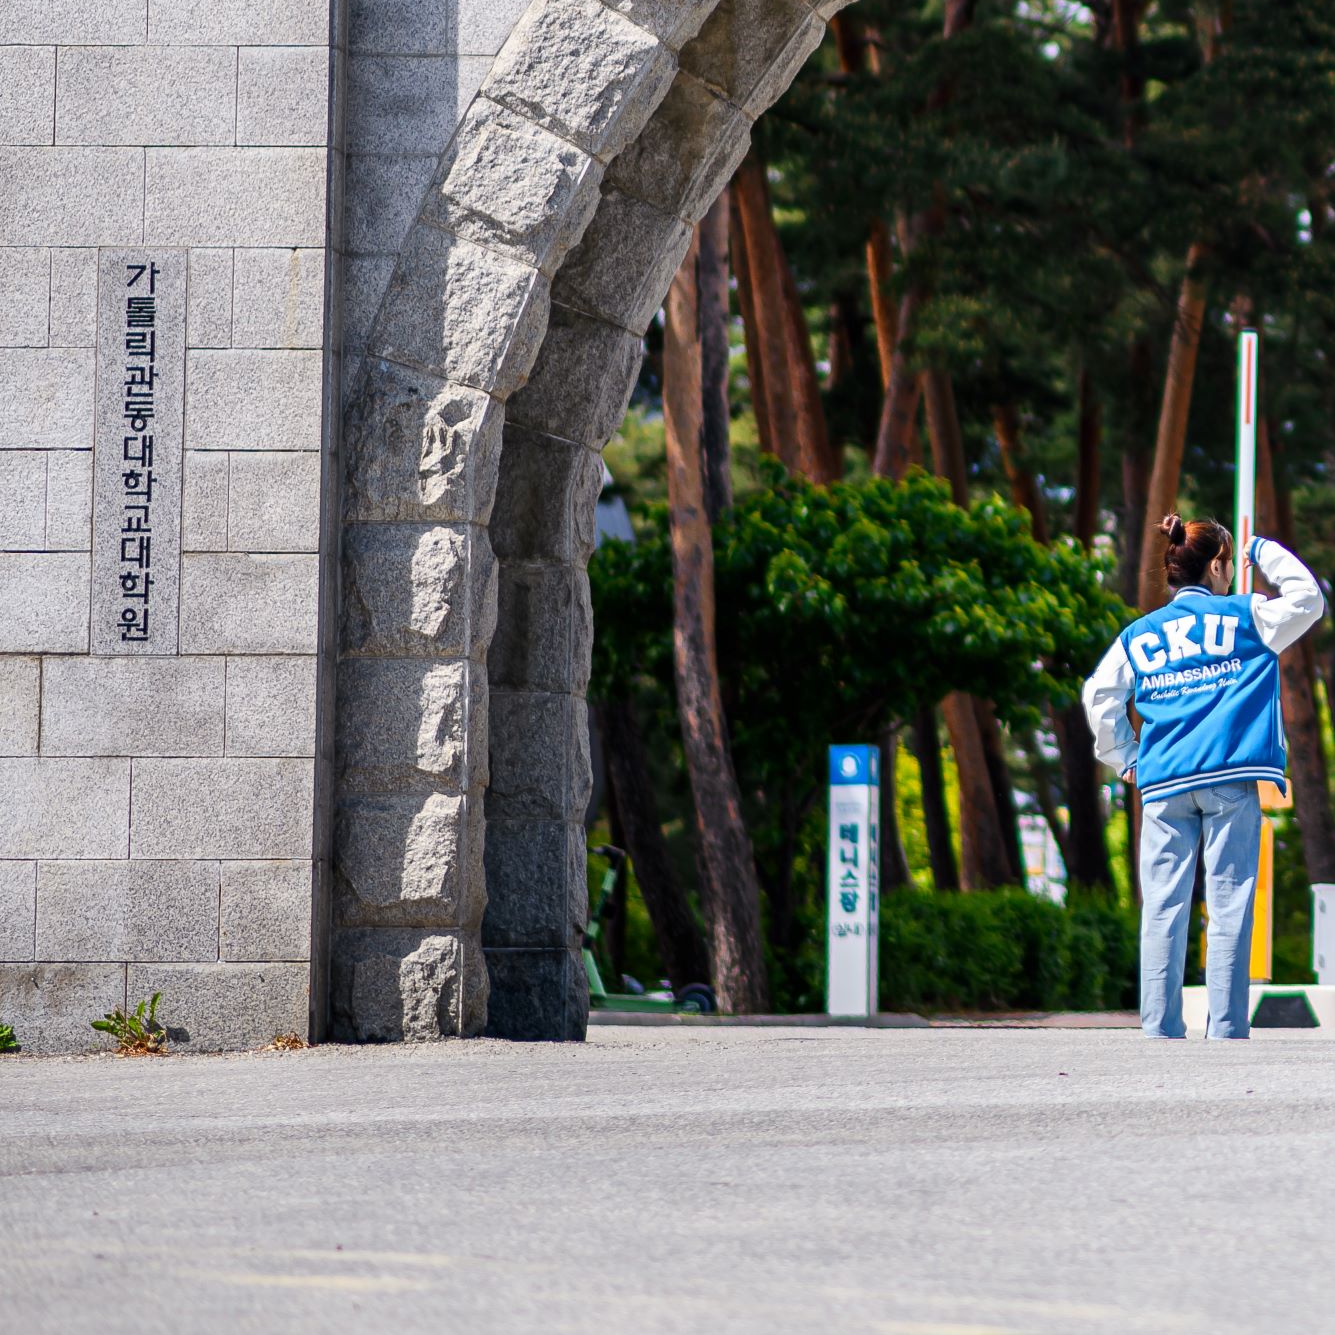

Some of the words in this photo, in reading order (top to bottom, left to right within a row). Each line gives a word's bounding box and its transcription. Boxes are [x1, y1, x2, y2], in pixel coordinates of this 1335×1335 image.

[116, 261, 161, 643] 가톨릭관동대학교대학원
[1129, 613, 1239, 673] CKU
[1141, 658, 1243, 690] AMBASSADOR
